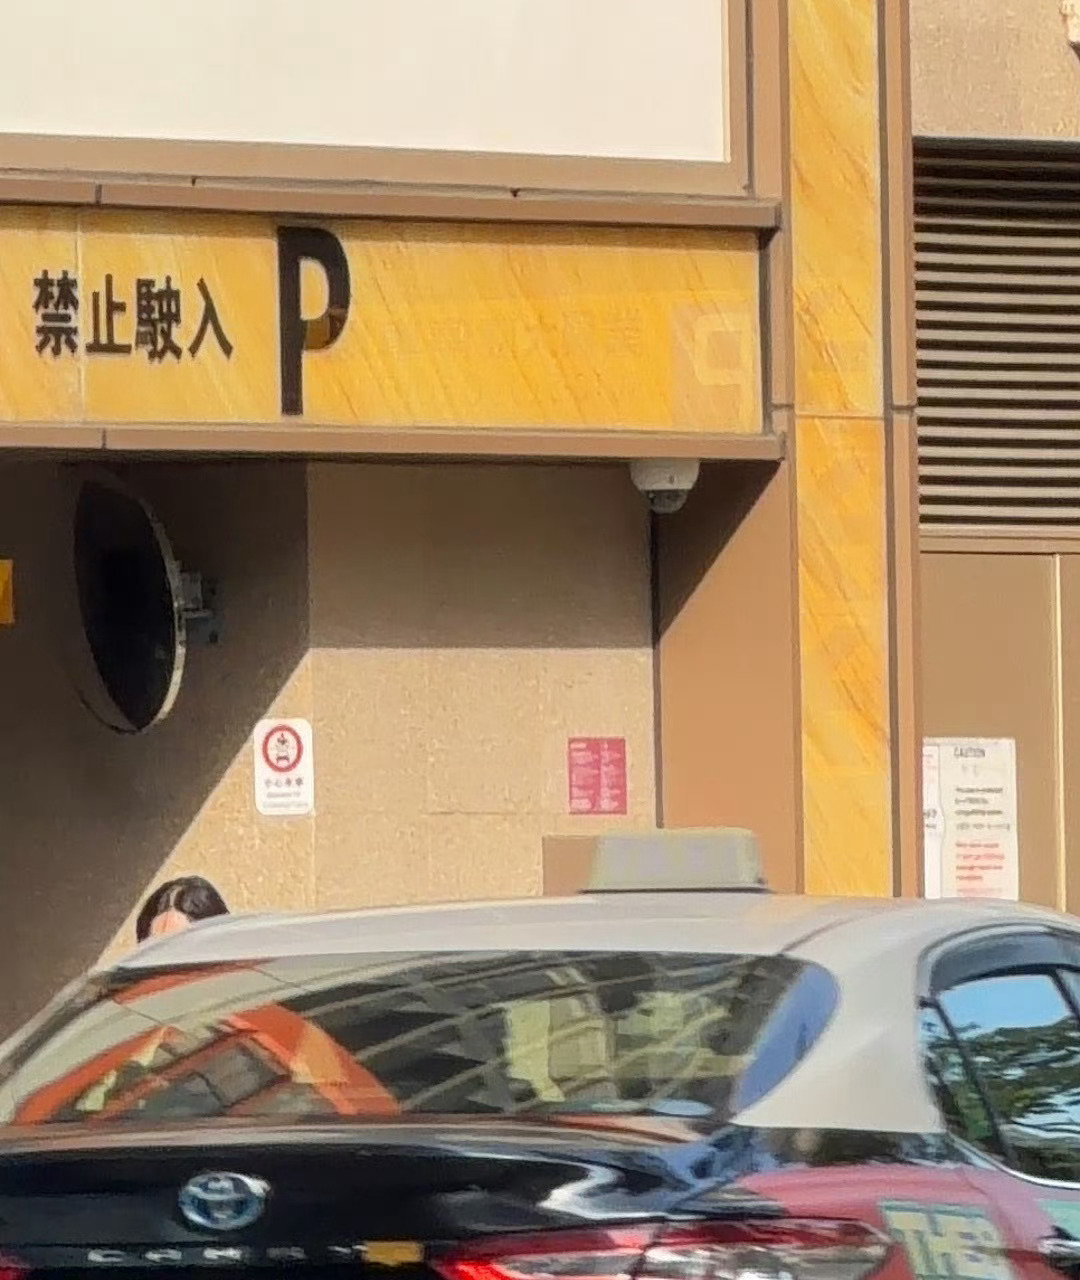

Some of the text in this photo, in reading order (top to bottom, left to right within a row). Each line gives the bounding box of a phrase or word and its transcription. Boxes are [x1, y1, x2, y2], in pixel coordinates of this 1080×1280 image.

[32, 269, 233, 361] 禁止駛入
[278, 225, 350, 416] P
